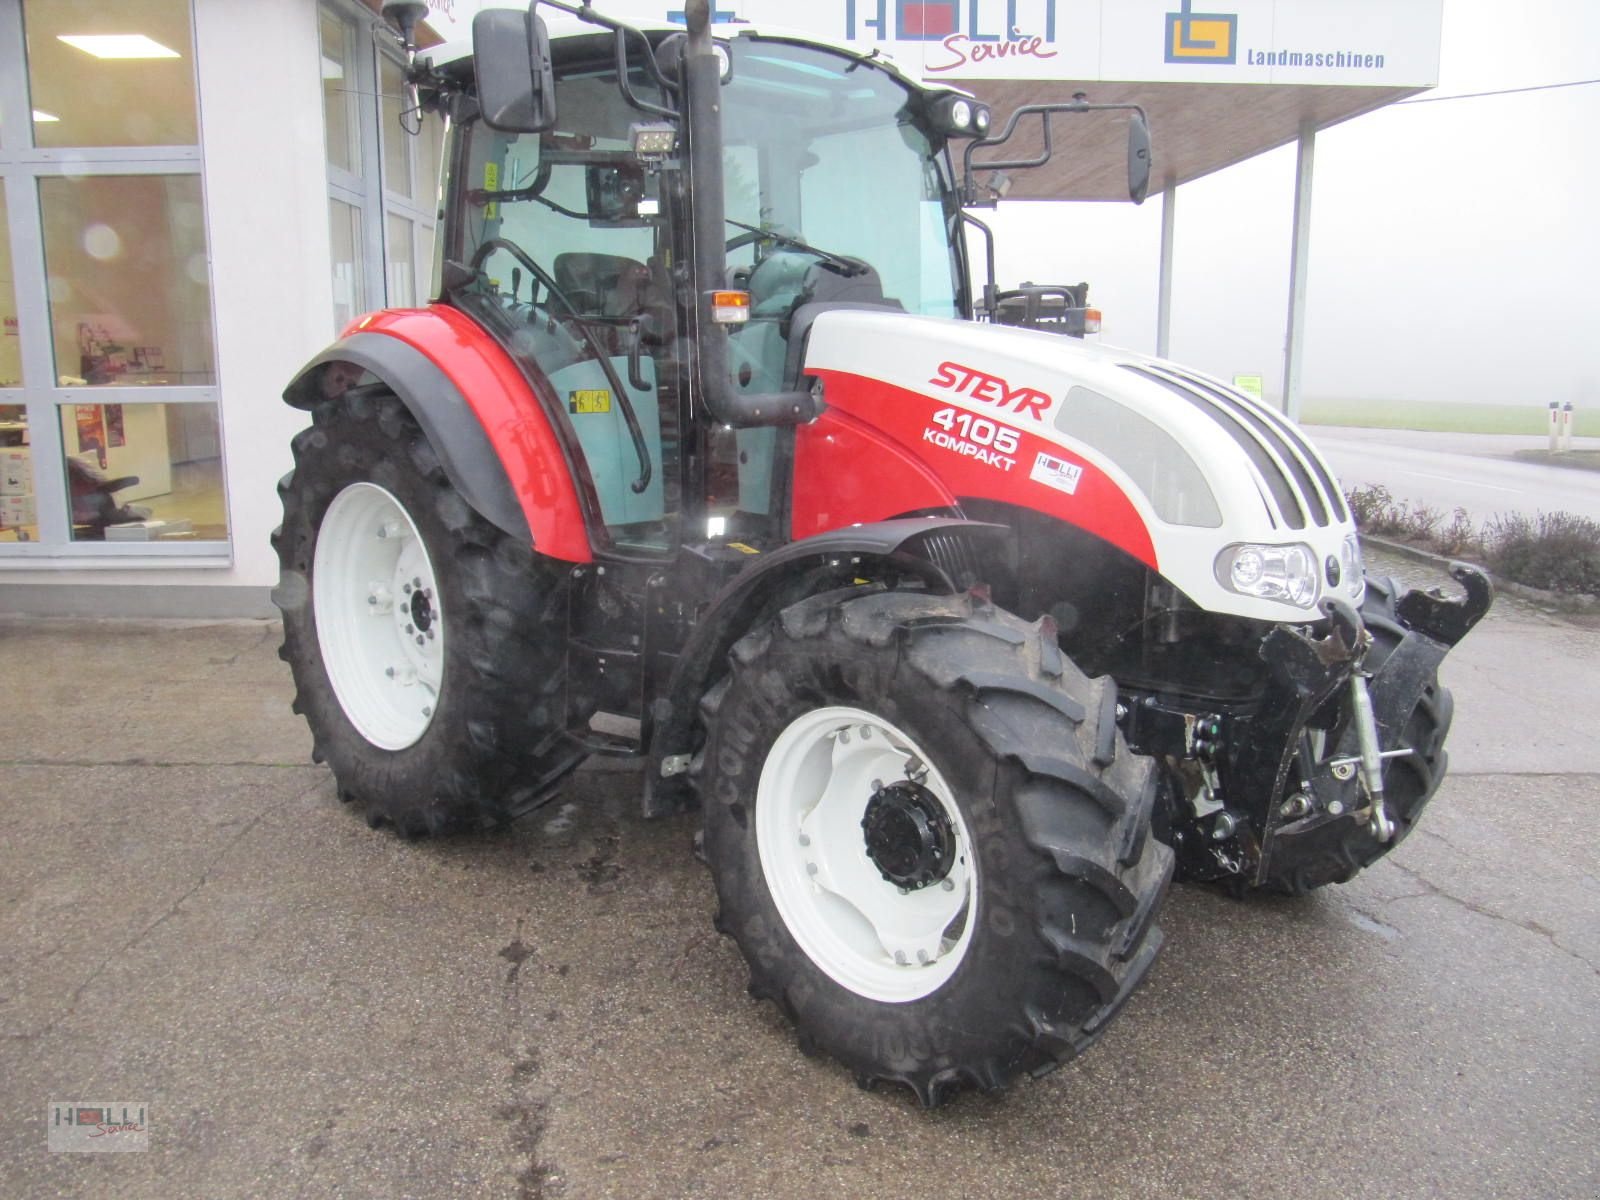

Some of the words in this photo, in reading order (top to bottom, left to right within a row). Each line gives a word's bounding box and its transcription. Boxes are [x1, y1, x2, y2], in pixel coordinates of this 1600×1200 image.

[925, 26, 1058, 72] Service
[1247, 48, 1385, 68] Landmaschinen
[928, 361, 1052, 421] STEYR
[922, 427, 1017, 472] KOMPAKT
[932, 407, 1021, 455] 4105
